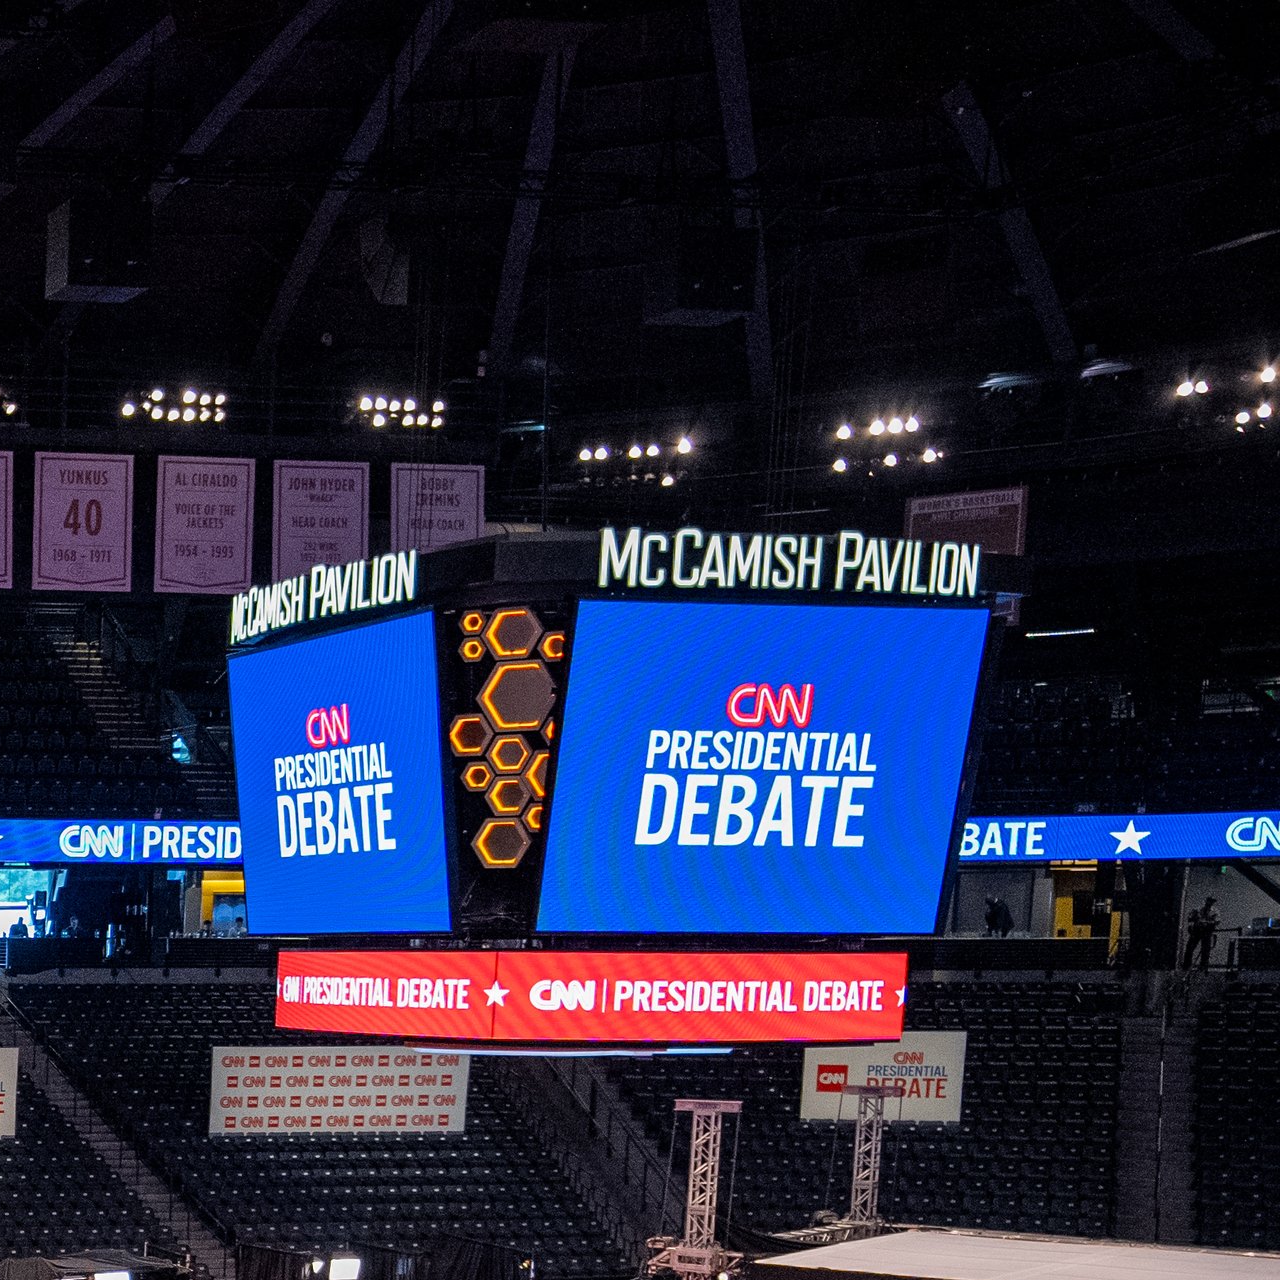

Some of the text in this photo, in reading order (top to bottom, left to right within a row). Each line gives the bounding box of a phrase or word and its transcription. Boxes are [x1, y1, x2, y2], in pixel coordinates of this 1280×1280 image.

[58, 469, 109, 486] YUNKUS
[174, 471, 190, 486] AL
[62, 498, 103, 537] 40
[51, 549, 111, 564] 1968 1971
[834, 530, 981, 598] PAVILION
[308, 549, 417, 620] PAVILION
[724, 683, 815, 729] CNN
[305, 702, 351, 749] CNN
[274, 742, 393, 792] PRESIDENTIAL
[645, 730, 878, 773] PRESIDENTIAL
[276, 782, 397, 858] DEBATE
[634, 774, 874, 848] DEBATE
[59, 825, 242, 859] CNN PRESID
[302, 976, 393, 1007] PRESIDENTIAL
[396, 978, 472, 1010] DEBATE
[529, 979, 885, 1012] CNN PRESIDENTIAL DEBATE
[867, 1065, 948, 1078] PRESIDENTIAL
[893, 1051, 925, 1065] CNN
[819, 1072, 845, 1085] CNN
